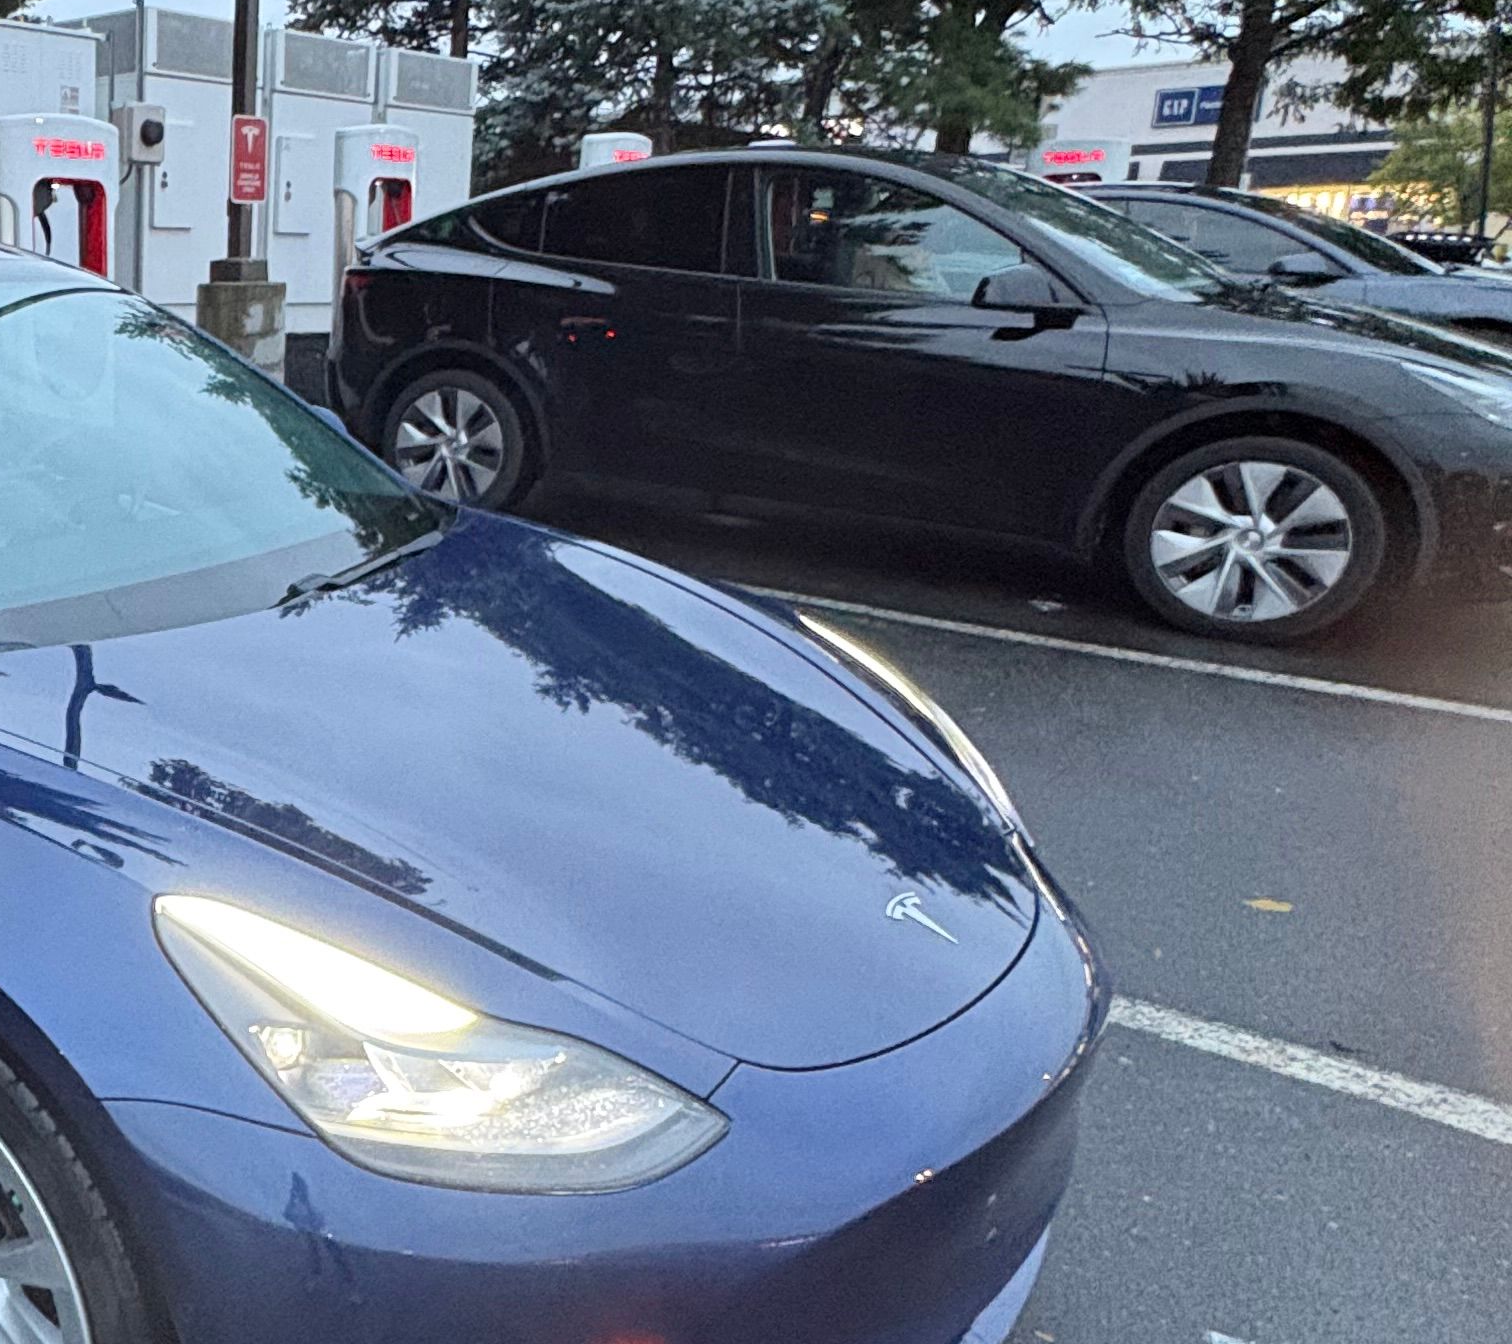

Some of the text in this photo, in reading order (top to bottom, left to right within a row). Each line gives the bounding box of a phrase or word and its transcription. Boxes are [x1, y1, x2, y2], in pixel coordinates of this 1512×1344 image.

[32, 138, 105, 160] TESLA
[370, 144, 414, 163] TESLA
[1043, 149, 1105, 166] TESLA
